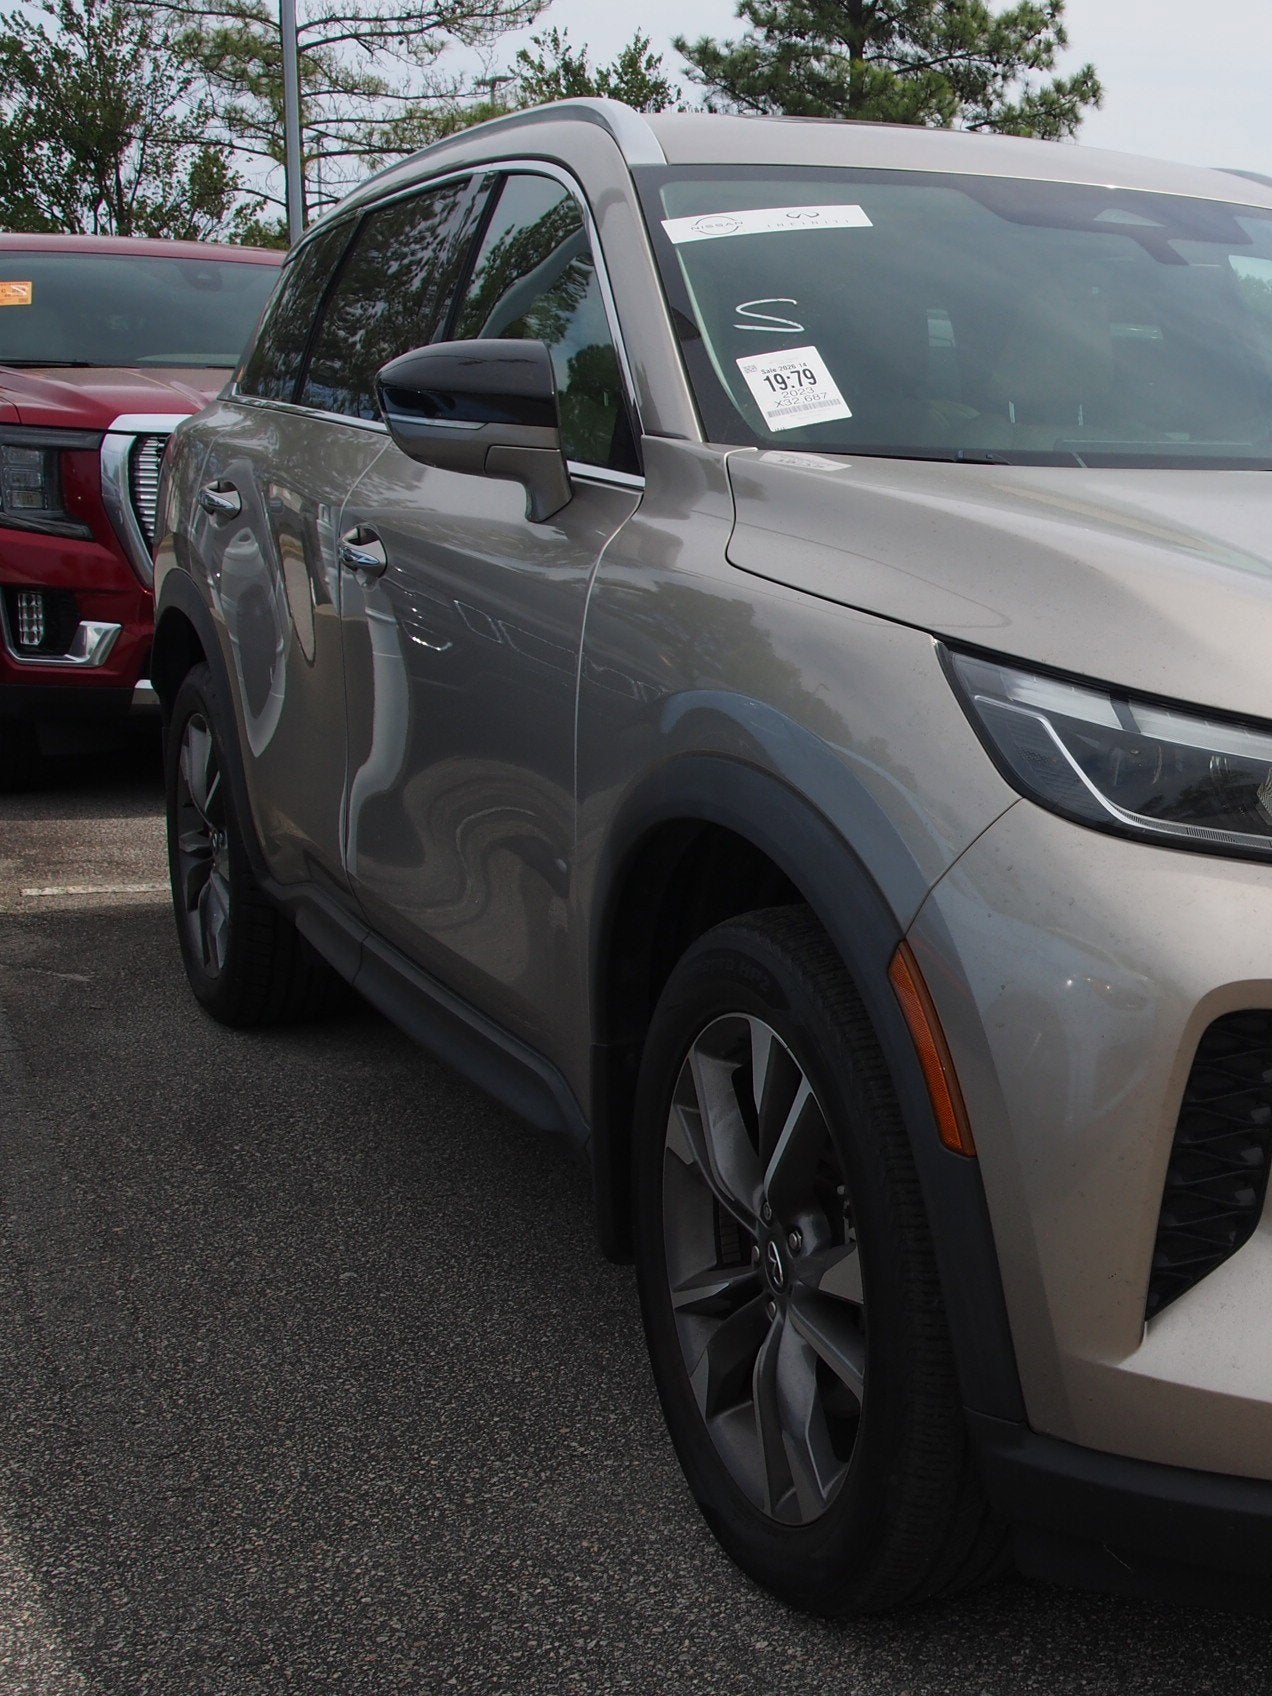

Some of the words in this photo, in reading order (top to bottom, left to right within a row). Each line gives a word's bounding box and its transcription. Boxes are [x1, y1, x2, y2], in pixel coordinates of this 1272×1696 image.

[690, 220, 744, 232] NISSAN
[763, 368, 817, 392] 19:79
[781, 386, 815, 399] 2023
